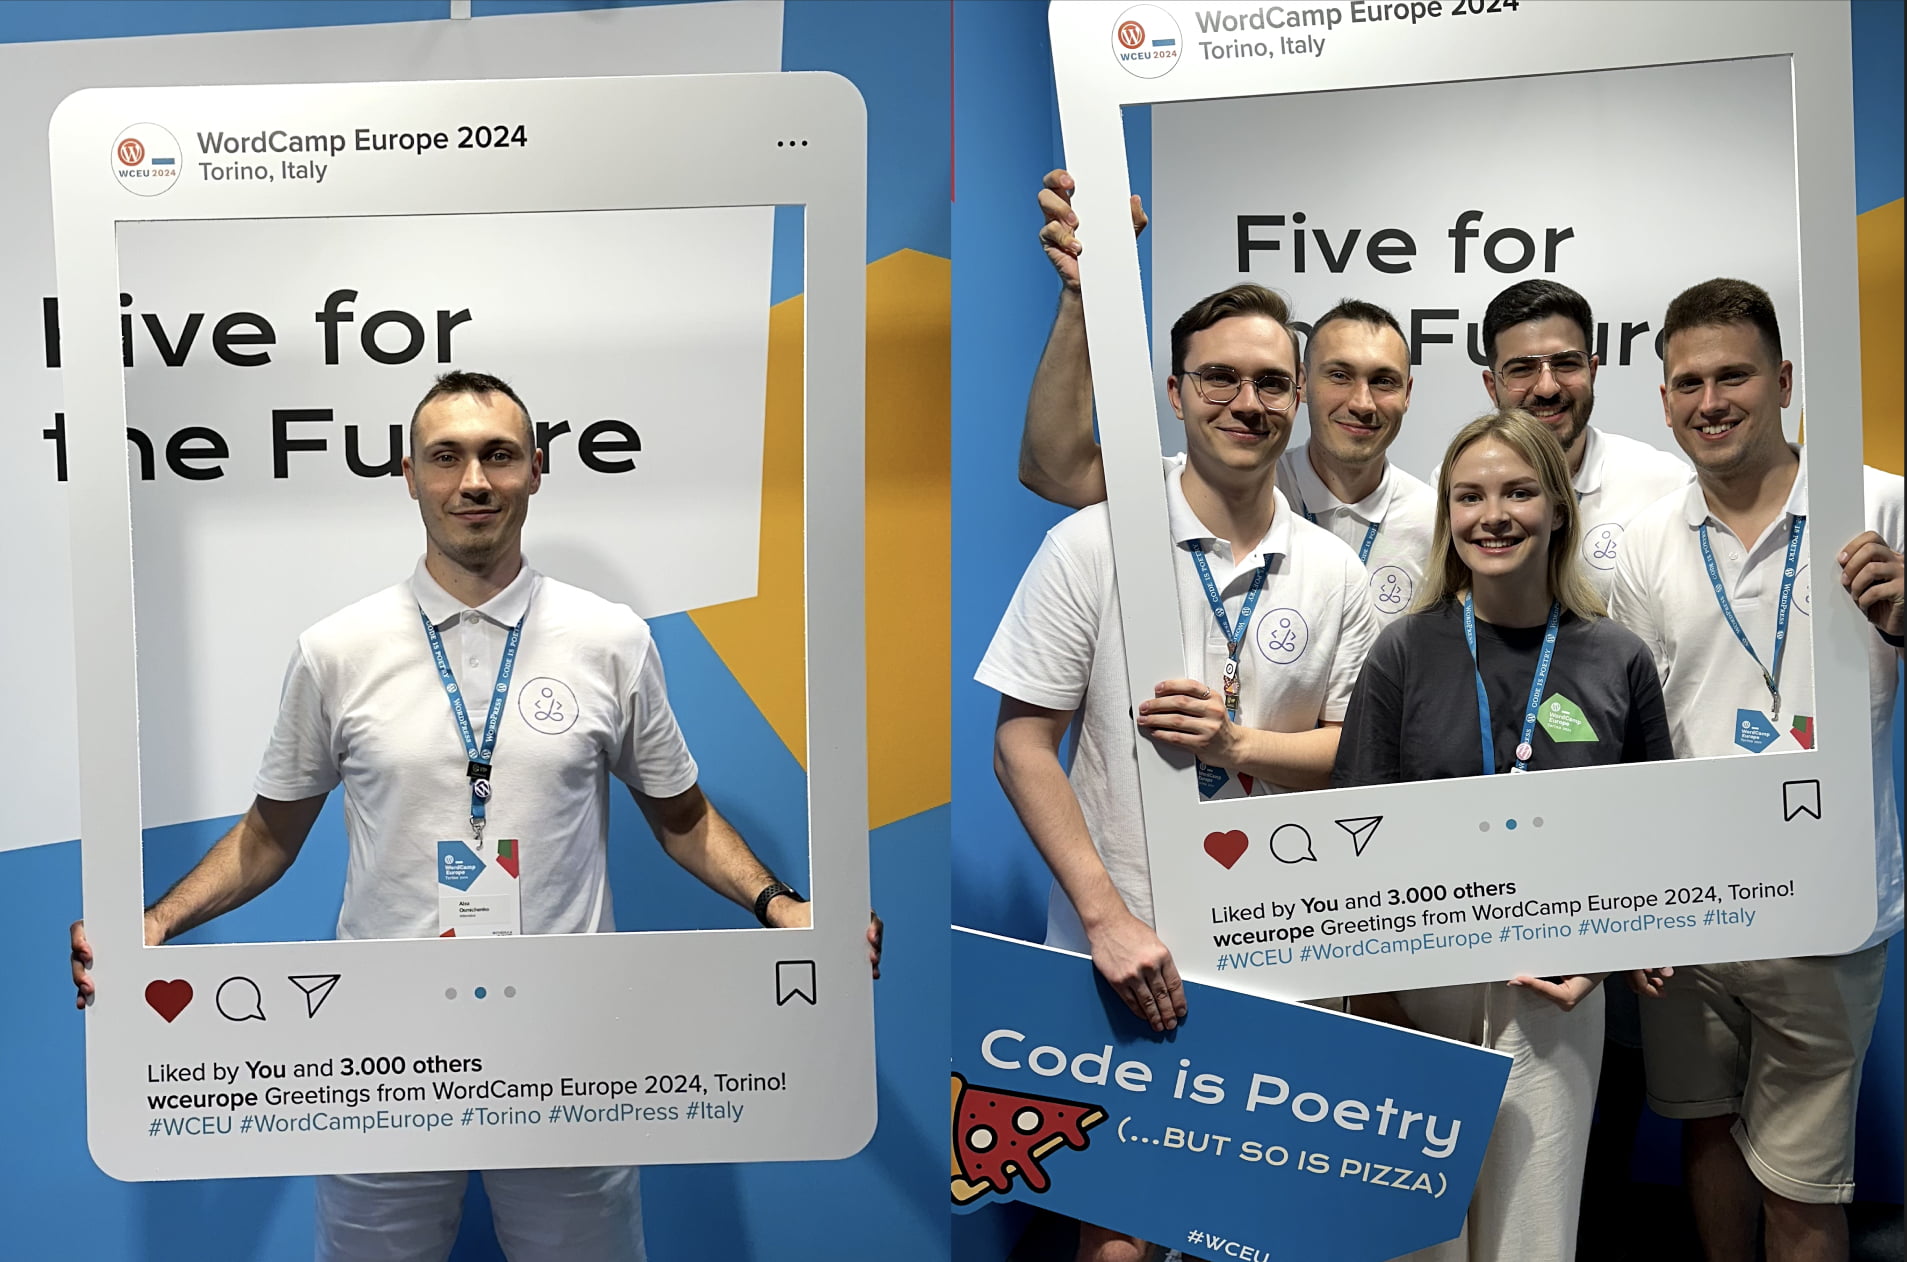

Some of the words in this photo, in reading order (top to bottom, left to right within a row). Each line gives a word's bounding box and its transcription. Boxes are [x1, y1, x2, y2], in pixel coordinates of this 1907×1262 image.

[1195, 6, 1342, 33] WordCamp
[1351, 1, 1442, 24] Europe
[1120, 51, 1150, 61] WCEU
[1153, 50, 1177, 59] 2024
[1199, 39, 1274, 60] Torino,
[1280, 35, 1326, 57] Italy
[197, 130, 346, 157] WordCamp
[355, 128, 449, 155] Europe
[457, 125, 527, 149] 2024
[119, 169, 150, 178] WCEU
[152, 169, 176, 177] 2024
[198, 161, 274, 182] Torino,
[281, 160, 328, 183] Italy
[1237, 212, 1417, 274] Five
[1448, 209, 1575, 274] for
[315, 289, 472, 365] for
[272, 408, 642, 478] Fure
[1203, 573, 1211, 581] IS
[1206, 583, 1219, 603] CODE
[432, 641, 439, 650] IS
[435, 650, 450, 678] POETRY
[502, 658, 512, 678] CODE
[507, 648, 515, 657] IS
[1540, 648, 1551, 677] POETRY
[1537, 678, 1544, 686] IS
[1532, 688, 1541, 708] CODE
[1211, 903, 1265, 924] Liked
[1271, 901, 1296, 920] by
[1300, 897, 1339, 914] You
[1345, 891, 1381, 910] and
[1387, 885, 1447, 905] 3.000
[1453, 881, 1516, 899] others
[1213, 925, 1315, 947] wceurope
[1321, 913, 1416, 936] Greetings
[1422, 907, 1466, 927] from
[1472, 900, 1582, 921] WordCamp
[1588, 891, 1658, 912] Europe
[1664, 885, 1722, 906] 2024,
[1728, 880, 1794, 901] Torino!
[1216, 947, 1293, 971] #WCEU
[1300, 928, 1493, 962] #WordCampEurope
[1499, 922, 1572, 943] #Torino
[1578, 912, 1697, 936] #WordPress
[1703, 906, 1756, 927] #Italy
[147, 1062, 205, 1083] Liked
[213, 1061, 239, 1085] by
[246, 1061, 286, 1080] You
[293, 1058, 333, 1078] and
[340, 1057, 406, 1076] 3.000
[412, 1055, 483, 1075] others
[147, 1091, 258, 1111] wceurope
[265, 1084, 371, 1108] Greetings
[377, 1082, 426, 1102] from
[432, 1079, 554, 1101] WordCamp
[560, 1077, 638, 1099] Europe
[644, 1074, 708, 1095] 2024,
[714, 1072, 786, 1092] Torino!
[981, 1029, 1153, 1092] Code
[1173, 1058, 1225, 1105] is
[1245, 1073, 1462, 1159] Poetry
[148, 1115, 232, 1137] #WCEU
[240, 1110, 454, 1133] #WordCampEurope
[460, 1107, 541, 1127] #Torino
[548, 1103, 679, 1123] #WordPress
[686, 1100, 744, 1123] #Italy
[1117, 1116, 1232, 1156] (...BUT
[1239, 1141, 1289, 1166] SO
[1297, 1150, 1331, 1175] IS
[1339, 1158, 1448, 1199] PIZZA)
[1187, 1229, 1270, 1262] #WCEU
